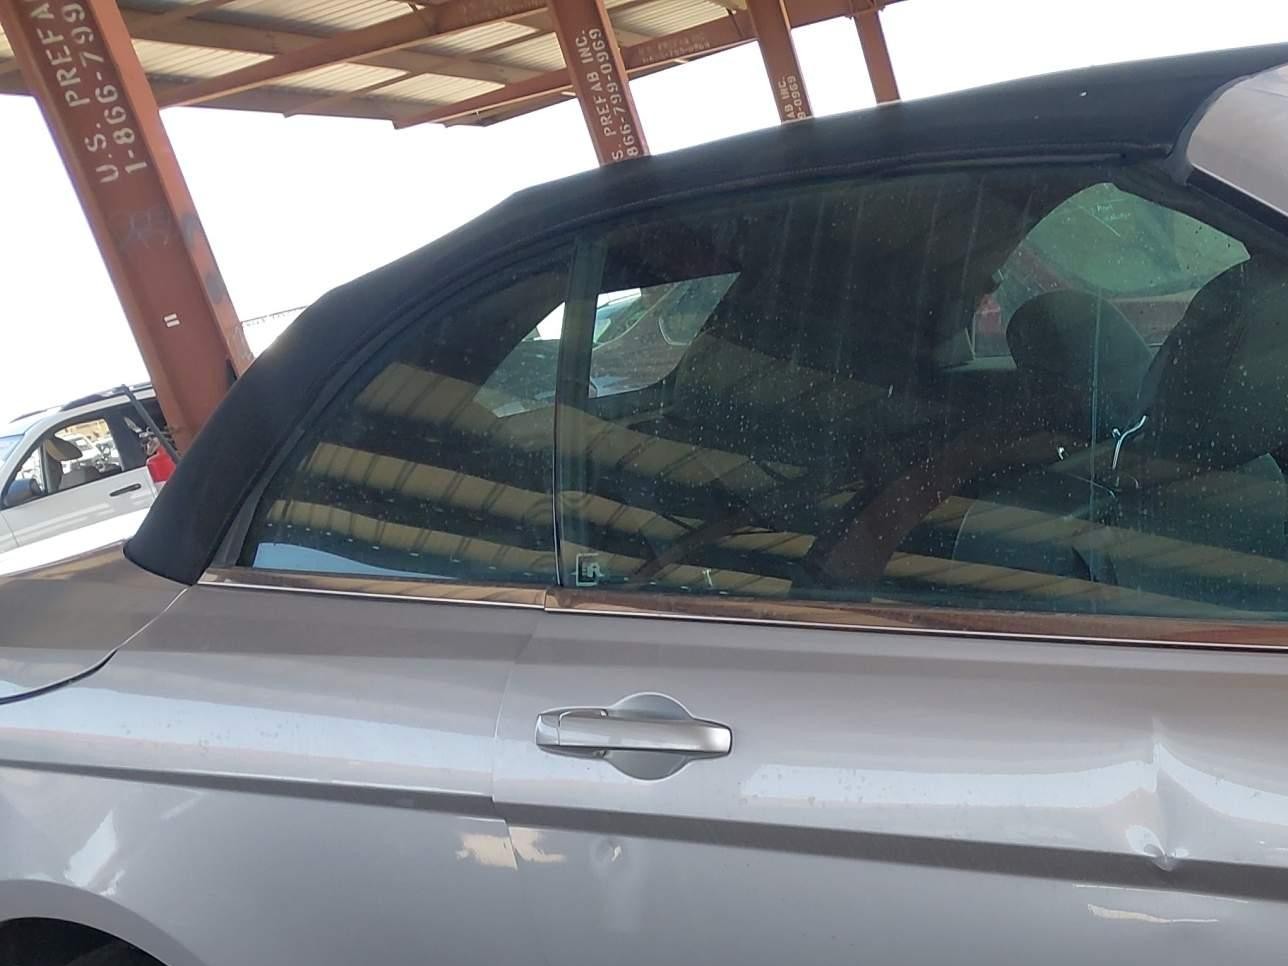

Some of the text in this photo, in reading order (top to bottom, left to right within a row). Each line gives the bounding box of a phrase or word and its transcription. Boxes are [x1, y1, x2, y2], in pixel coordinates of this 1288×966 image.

[28, 0, 120, 183] U.S. PREFA
[576, 30, 594, 64] INC.
